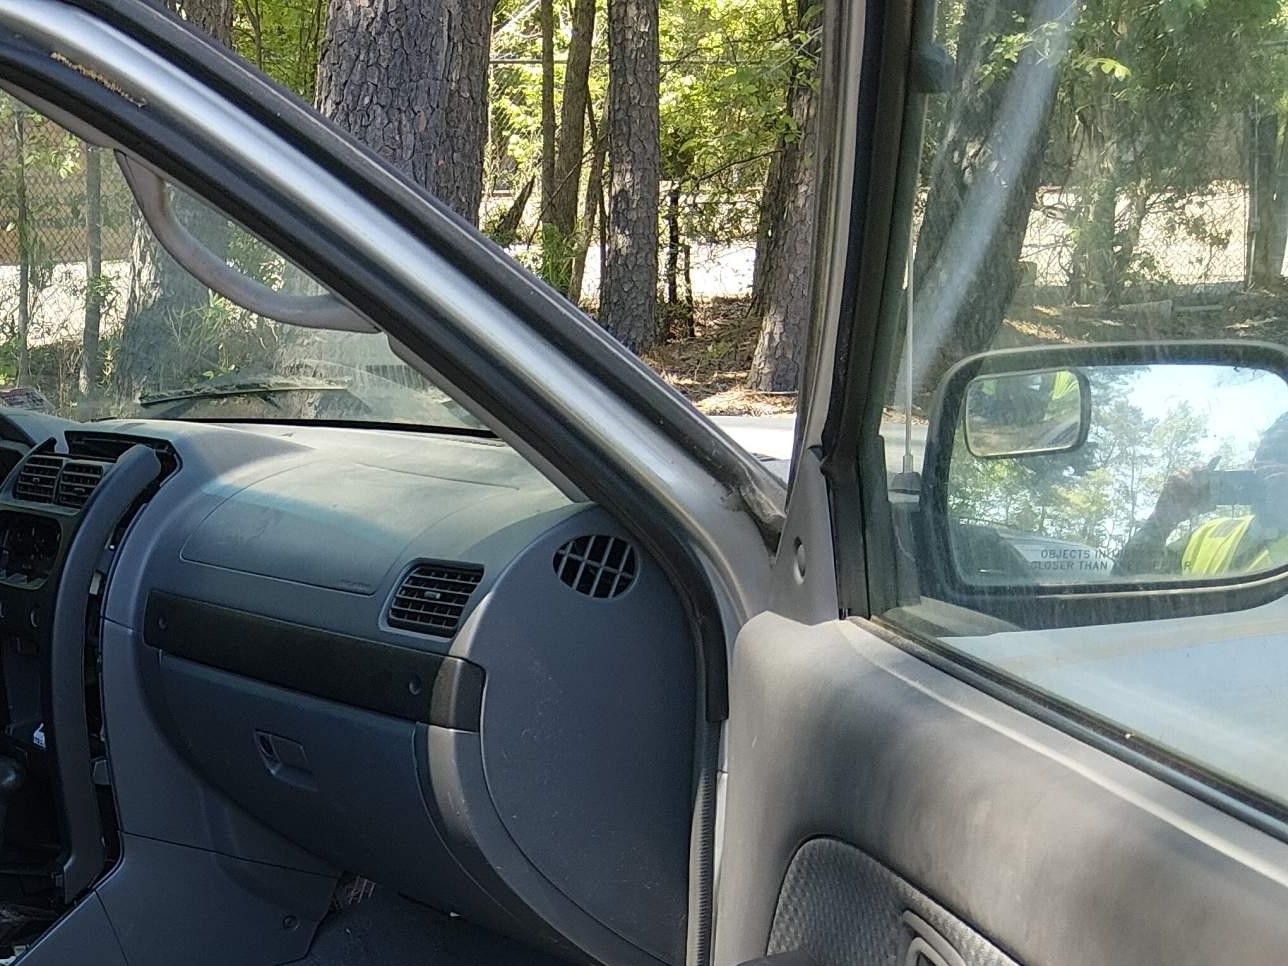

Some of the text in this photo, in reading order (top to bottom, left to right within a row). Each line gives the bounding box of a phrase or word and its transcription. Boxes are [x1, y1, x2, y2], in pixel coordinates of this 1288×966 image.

[1040, 549, 1090, 559] OBJECTS
[1030, 560, 1075, 570] CLOSER
[1078, 560, 1109, 570] THAN
